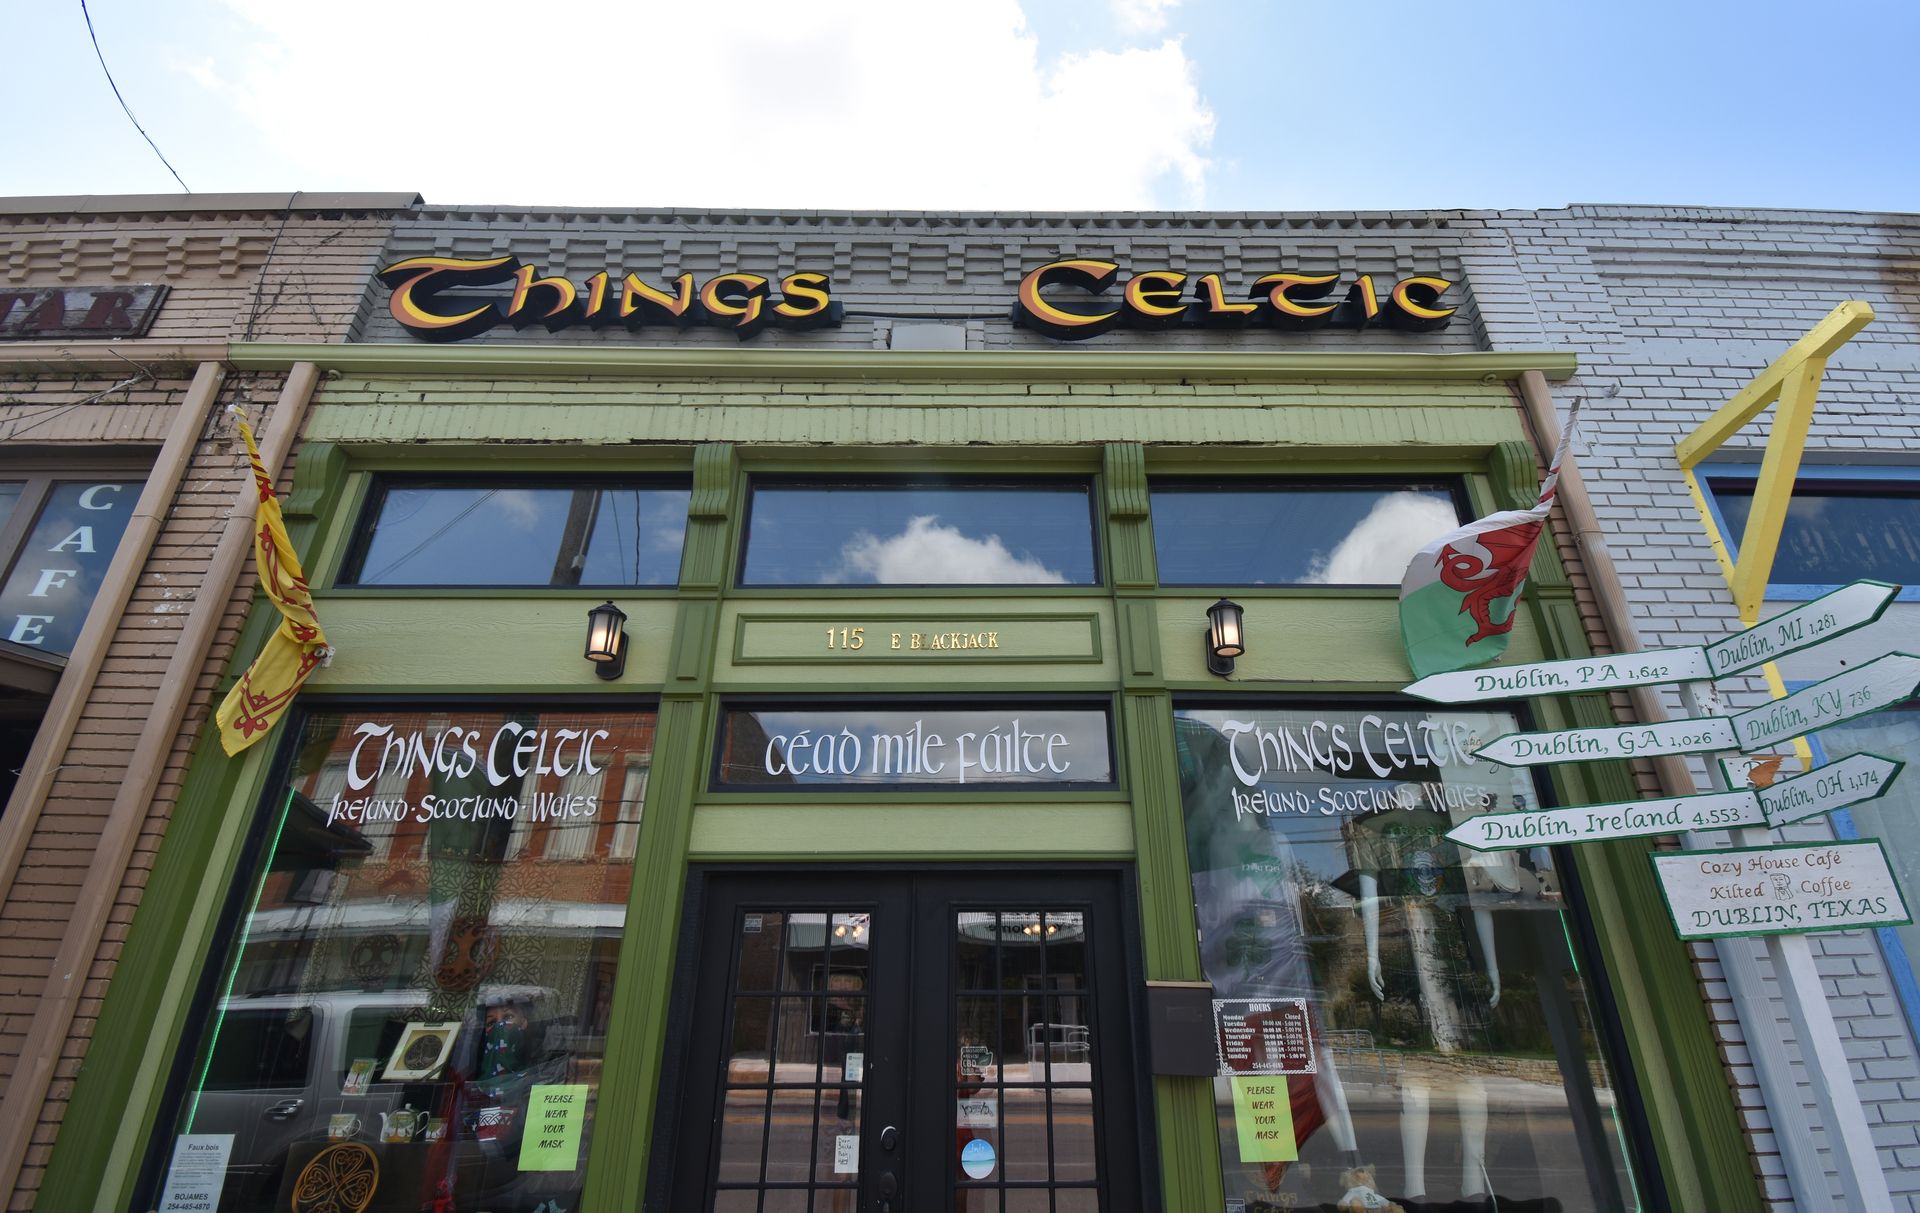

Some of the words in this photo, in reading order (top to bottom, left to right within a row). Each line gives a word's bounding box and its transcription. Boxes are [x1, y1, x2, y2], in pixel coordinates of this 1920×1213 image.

[9, 484, 122, 645] CAFE
[826, 627, 864, 650] 115
[891, 633, 901, 649] E
[1717, 631, 1774, 669] Dublin,
[1778, 617, 1804, 646] MI
[1809, 614, 1837, 636] 1,281
[1474, 668, 1569, 692] Dublin,
[1576, 664, 1620, 682] PA
[1628, 666, 1669, 680] 1,642
[1747, 705, 1808, 741] Dublin,
[1812, 689, 1842, 718] KY
[1849, 685, 1871, 708] 736
[1511, 733, 1609, 758] Dublin,
[1617, 730, 1663, 754] GA
[1670, 732, 1712, 747] 1,026
[1762, 786, 1814, 816] Dublin,
[1816, 770, 1845, 798] OH
[1849, 770, 1879, 790] 1,174
[1481, 816, 1577, 841] Dublin,
[1584, 803, 1684, 833] Ireland
[1692, 808, 1741, 826] 4,553
[1700, 860, 1742, 876] Cozy
[1747, 856, 1800, 871] House
[1804, 851, 1842, 869] Café
[1710, 881, 1765, 900] Kilted
[1800, 876, 1851, 896] Coffee
[1691, 904, 1802, 928] DUBLIN,
[1807, 896, 1888, 919] TEXAS
[1249, 1003, 1271, 1012] HOURS
[963, 1059, 976, 1068] CBD
[1246, 1086, 1275, 1094] PLEASE
[543, 1095, 575, 1103] PLEASE
[1252, 1101, 1274, 1109] WEAR
[545, 1110, 568, 1118] WEAR
[1254, 1116, 1276, 1124] YOUR
[543, 1124, 565, 1133] YOUR
[1255, 1131, 1279, 1139] MASK
[188, 1143, 205, 1151] Faux
[205, 1143, 219, 1151] bois
[538, 1140, 564, 1148] MASK
